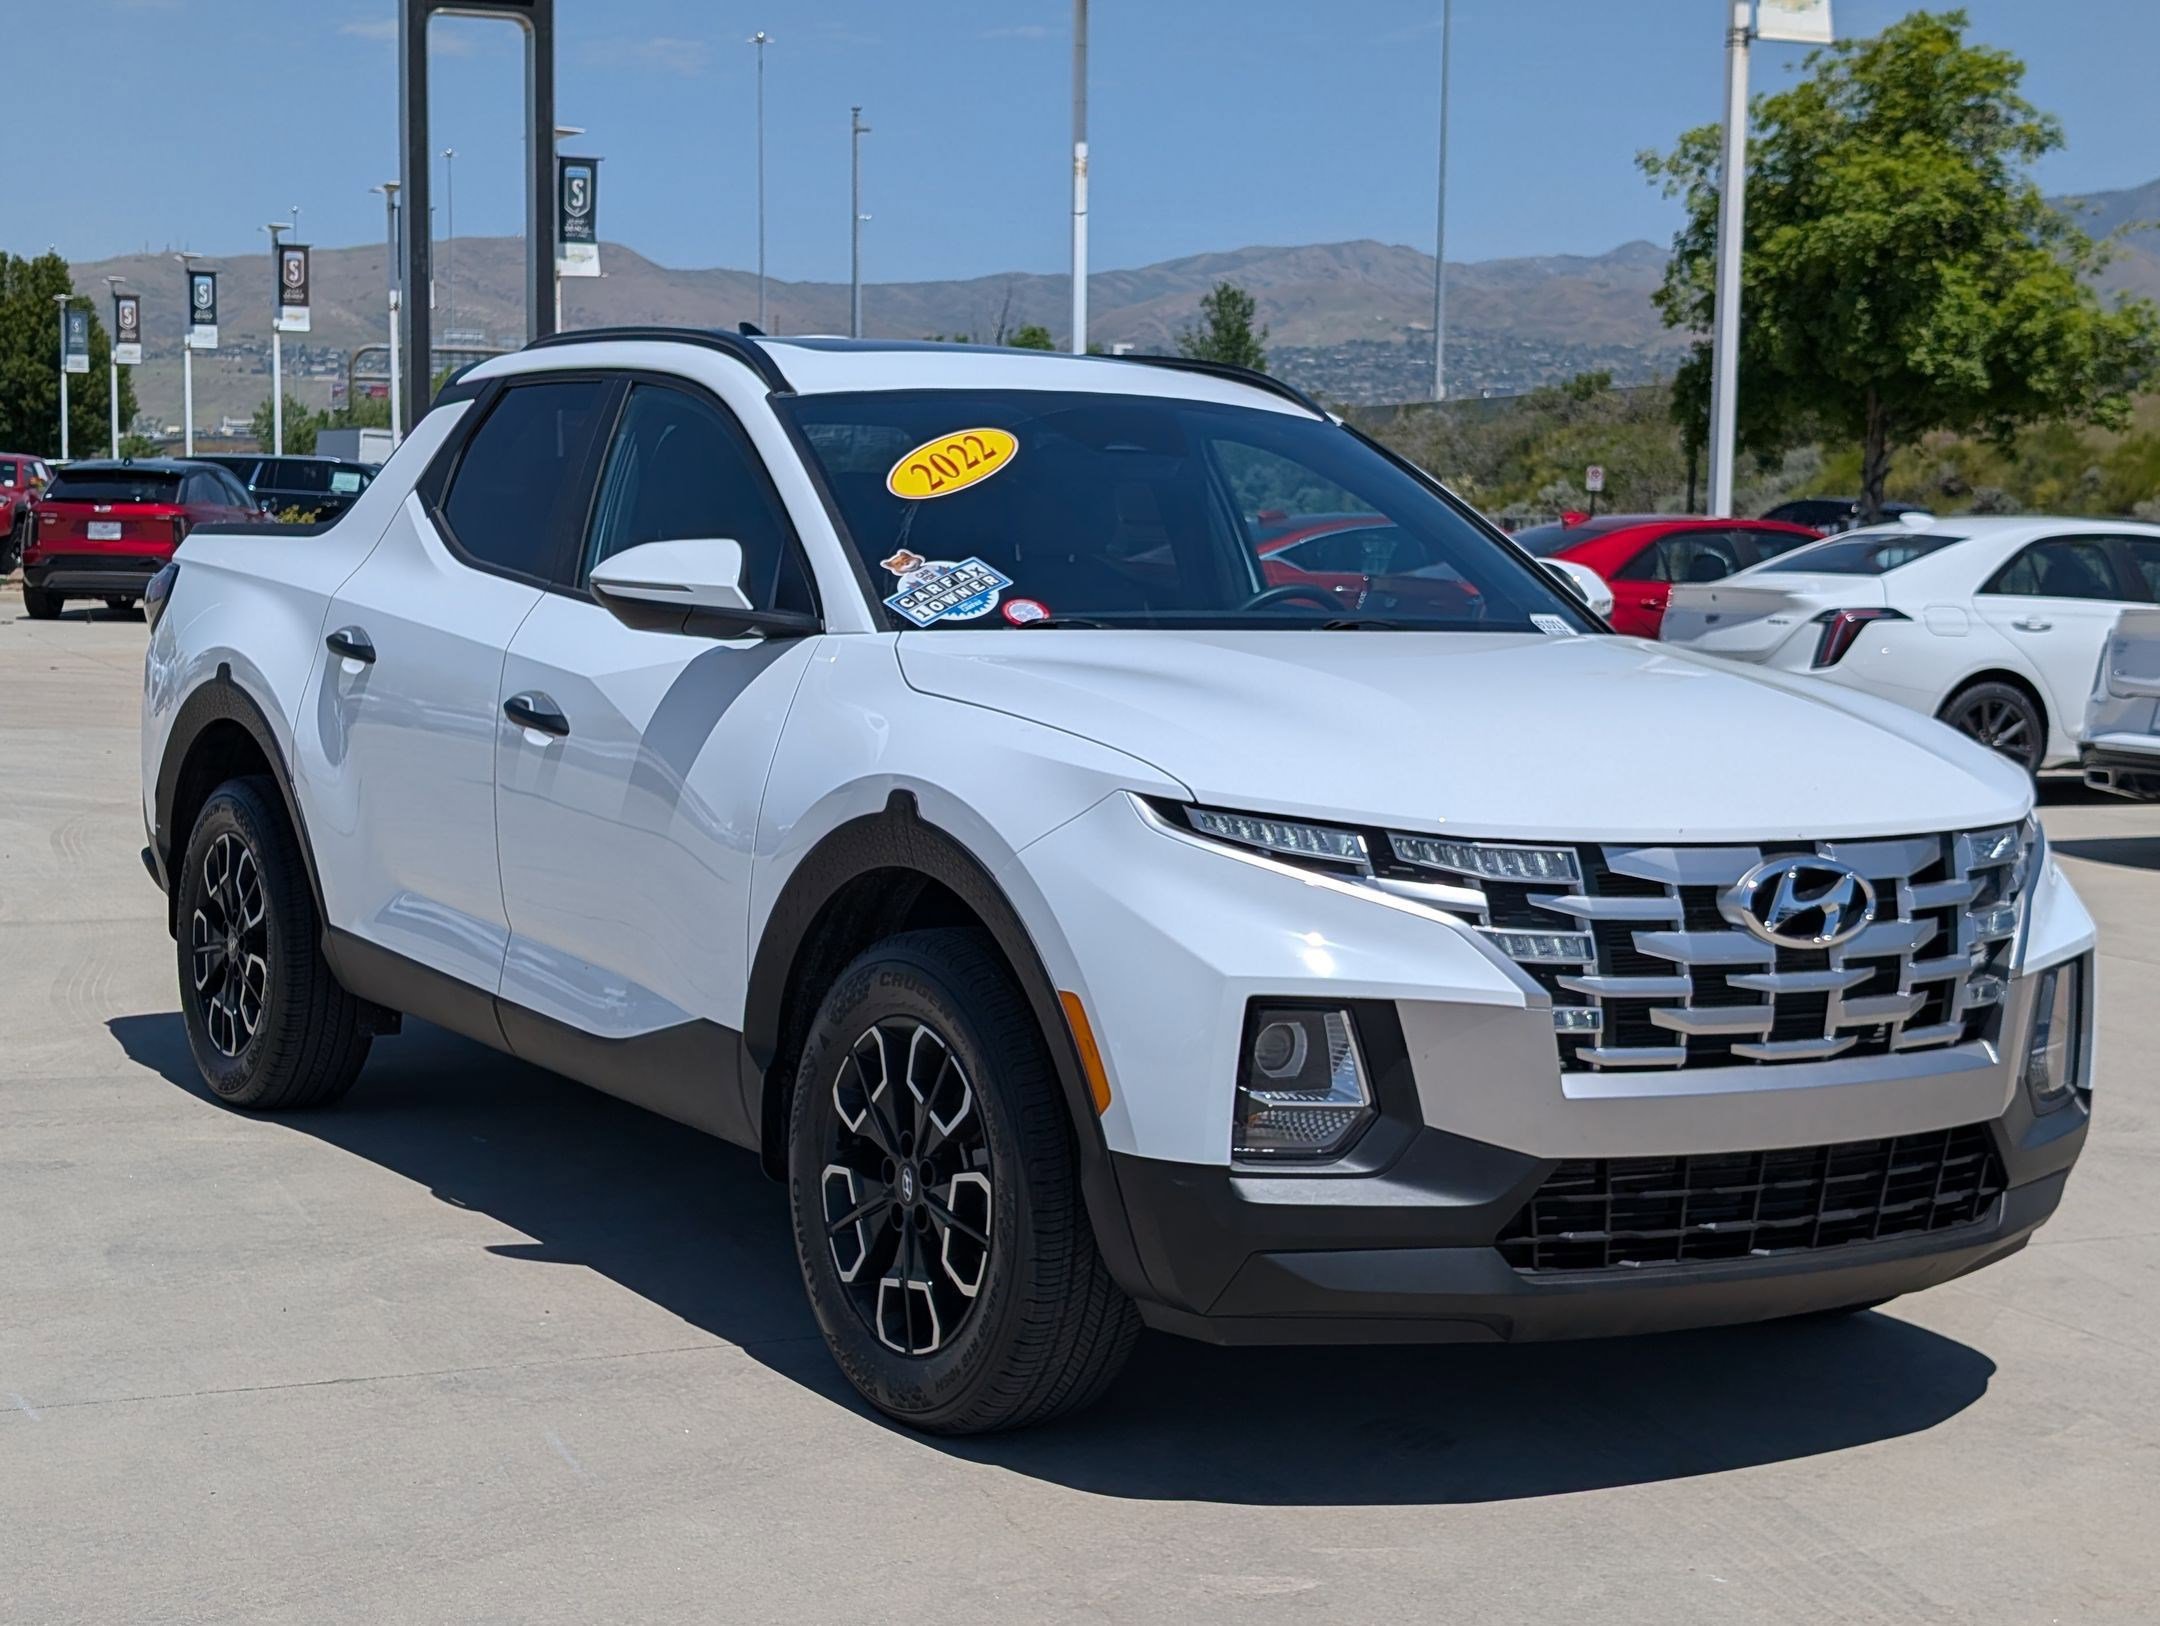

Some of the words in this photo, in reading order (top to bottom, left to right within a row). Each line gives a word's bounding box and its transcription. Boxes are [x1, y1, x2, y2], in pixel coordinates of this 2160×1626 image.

[570, 179, 584, 207] S
[289, 260, 299, 281] S
[910, 435, 997, 491] 2022
[899, 566, 985, 608] CARFAX
[879, 972, 953, 1022] CRUGEN
